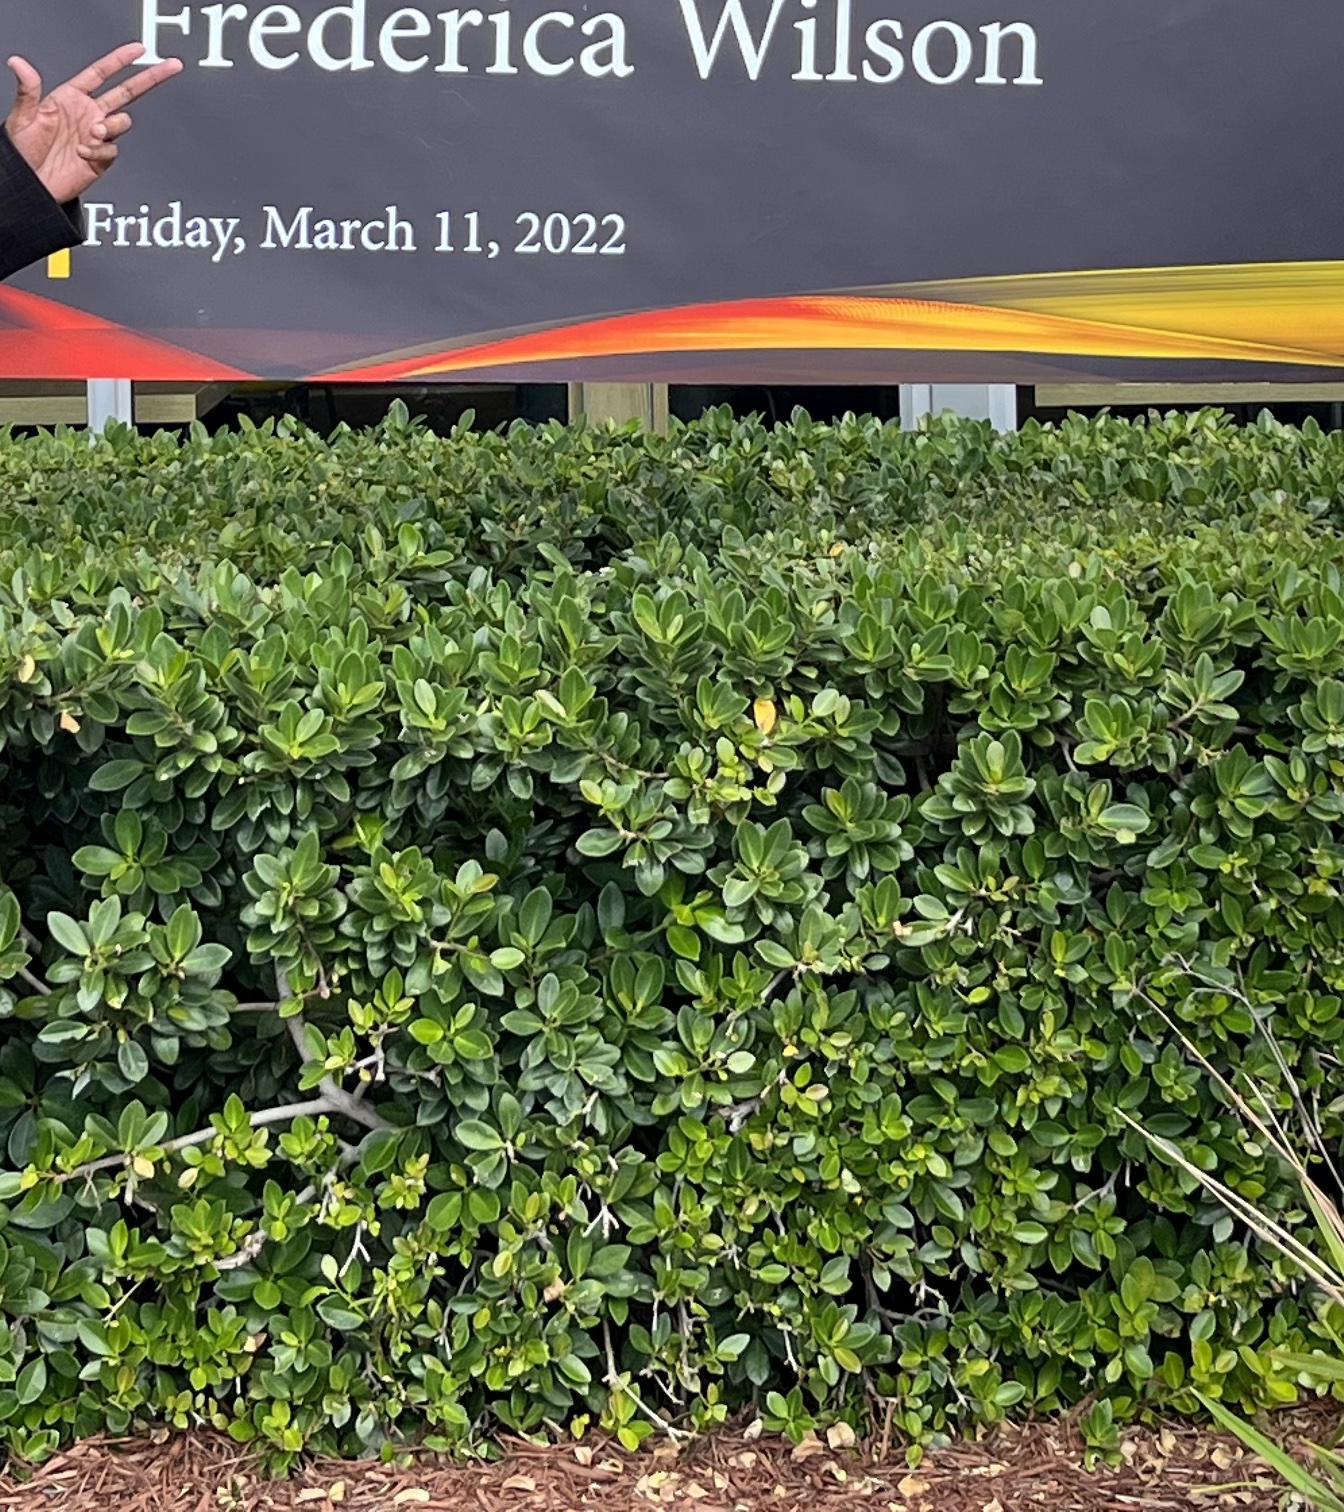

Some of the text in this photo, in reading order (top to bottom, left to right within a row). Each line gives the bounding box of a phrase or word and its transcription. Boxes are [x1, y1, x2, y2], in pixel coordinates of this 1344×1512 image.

[82, 200, 627, 263] Friday, March 11, 2022
